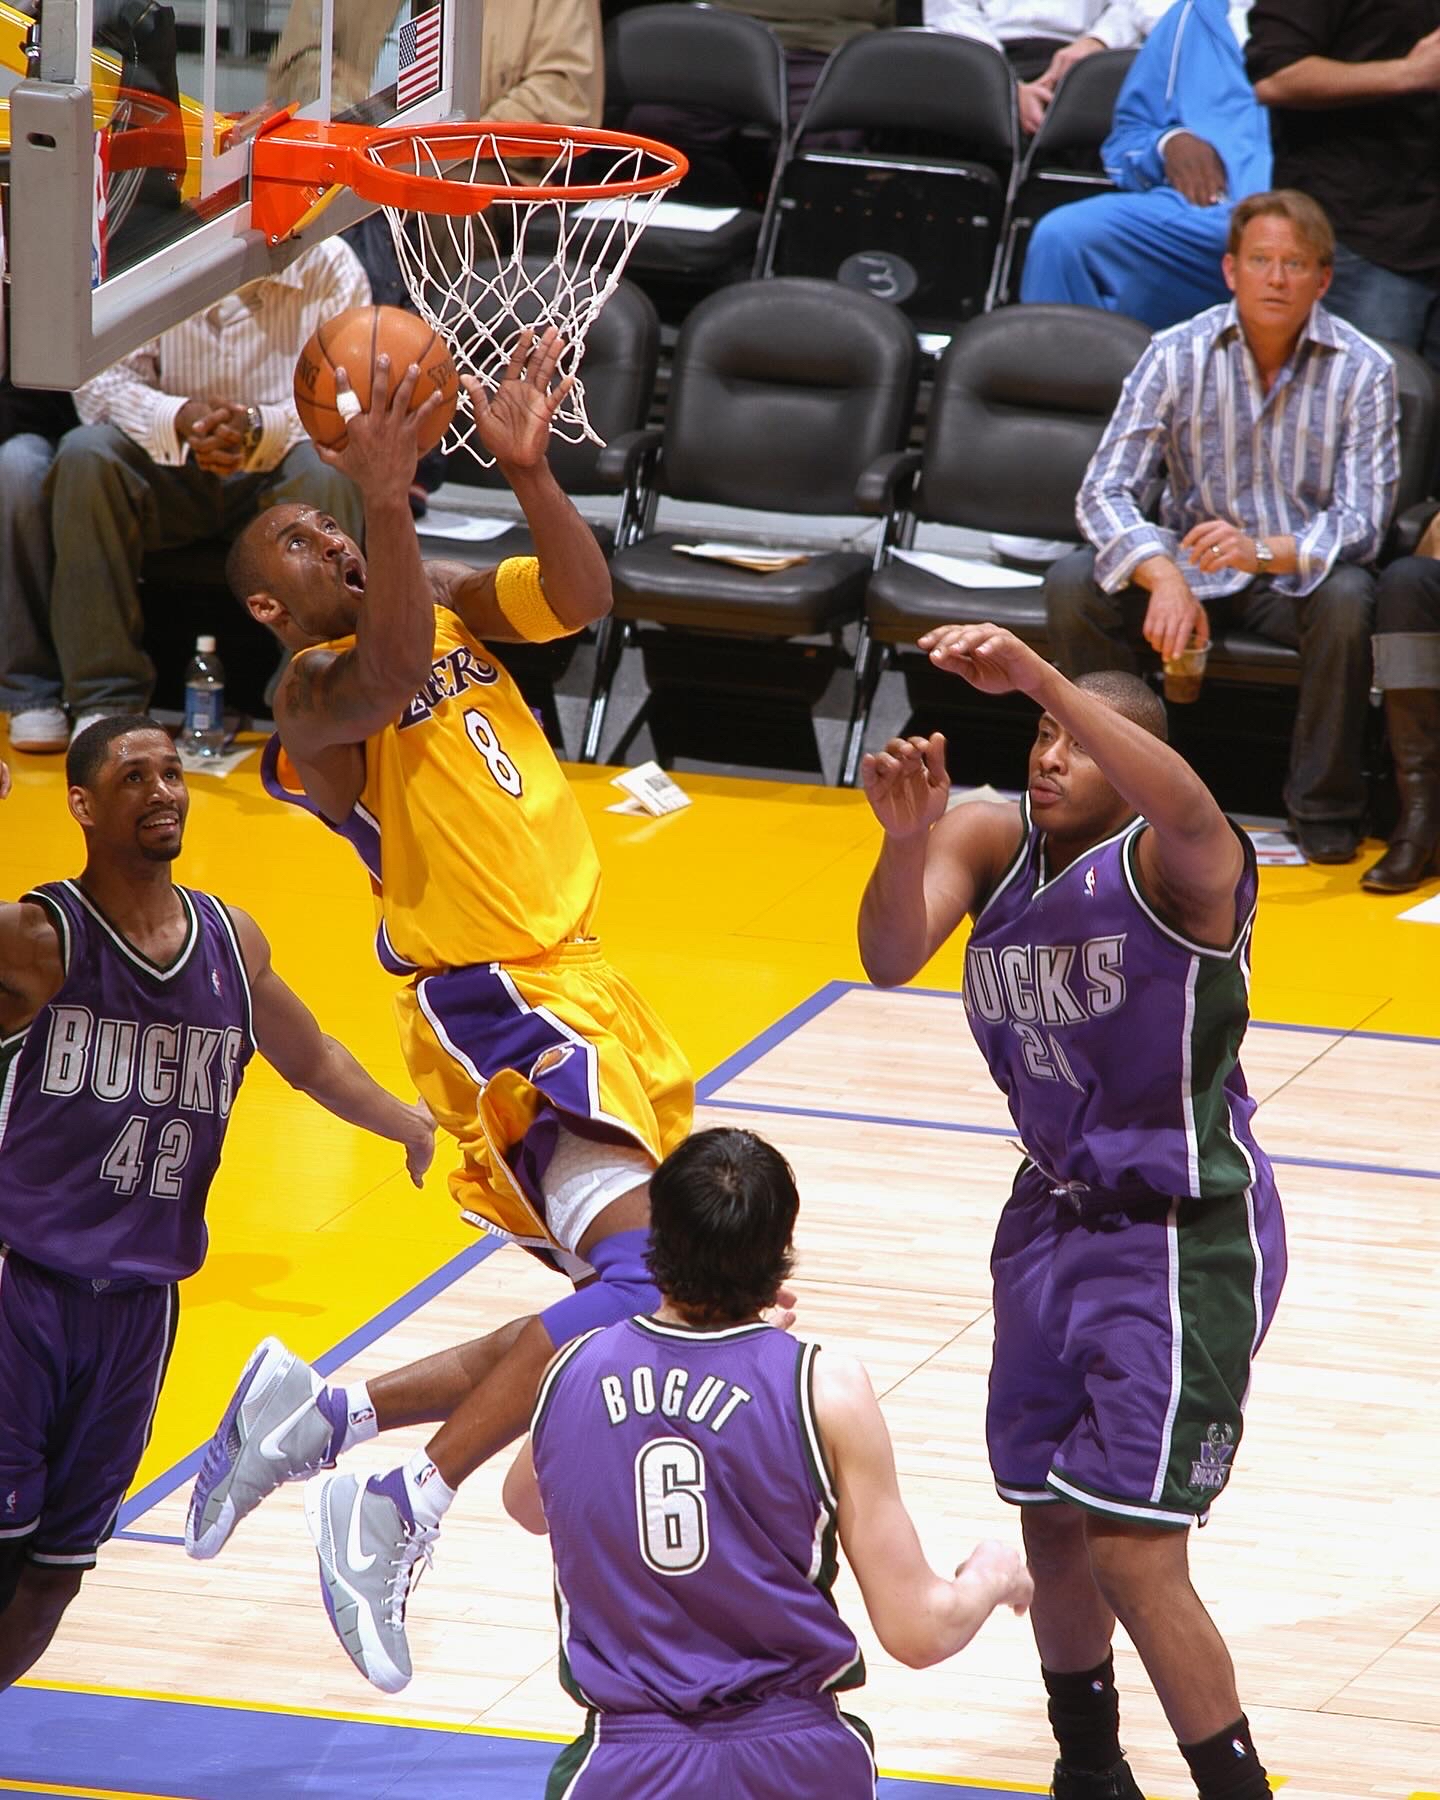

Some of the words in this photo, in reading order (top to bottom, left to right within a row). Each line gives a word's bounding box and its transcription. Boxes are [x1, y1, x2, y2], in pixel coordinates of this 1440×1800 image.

[857, 256, 898, 298] 3
[463, 707, 523, 799] 8
[963, 933, 1128, 1026] UCKS
[40, 1004, 242, 1119] BUCKS
[100, 1115, 193, 1200] 42
[600, 1365, 752, 1434] BOGUT
[634, 1436, 710, 1576] 6
